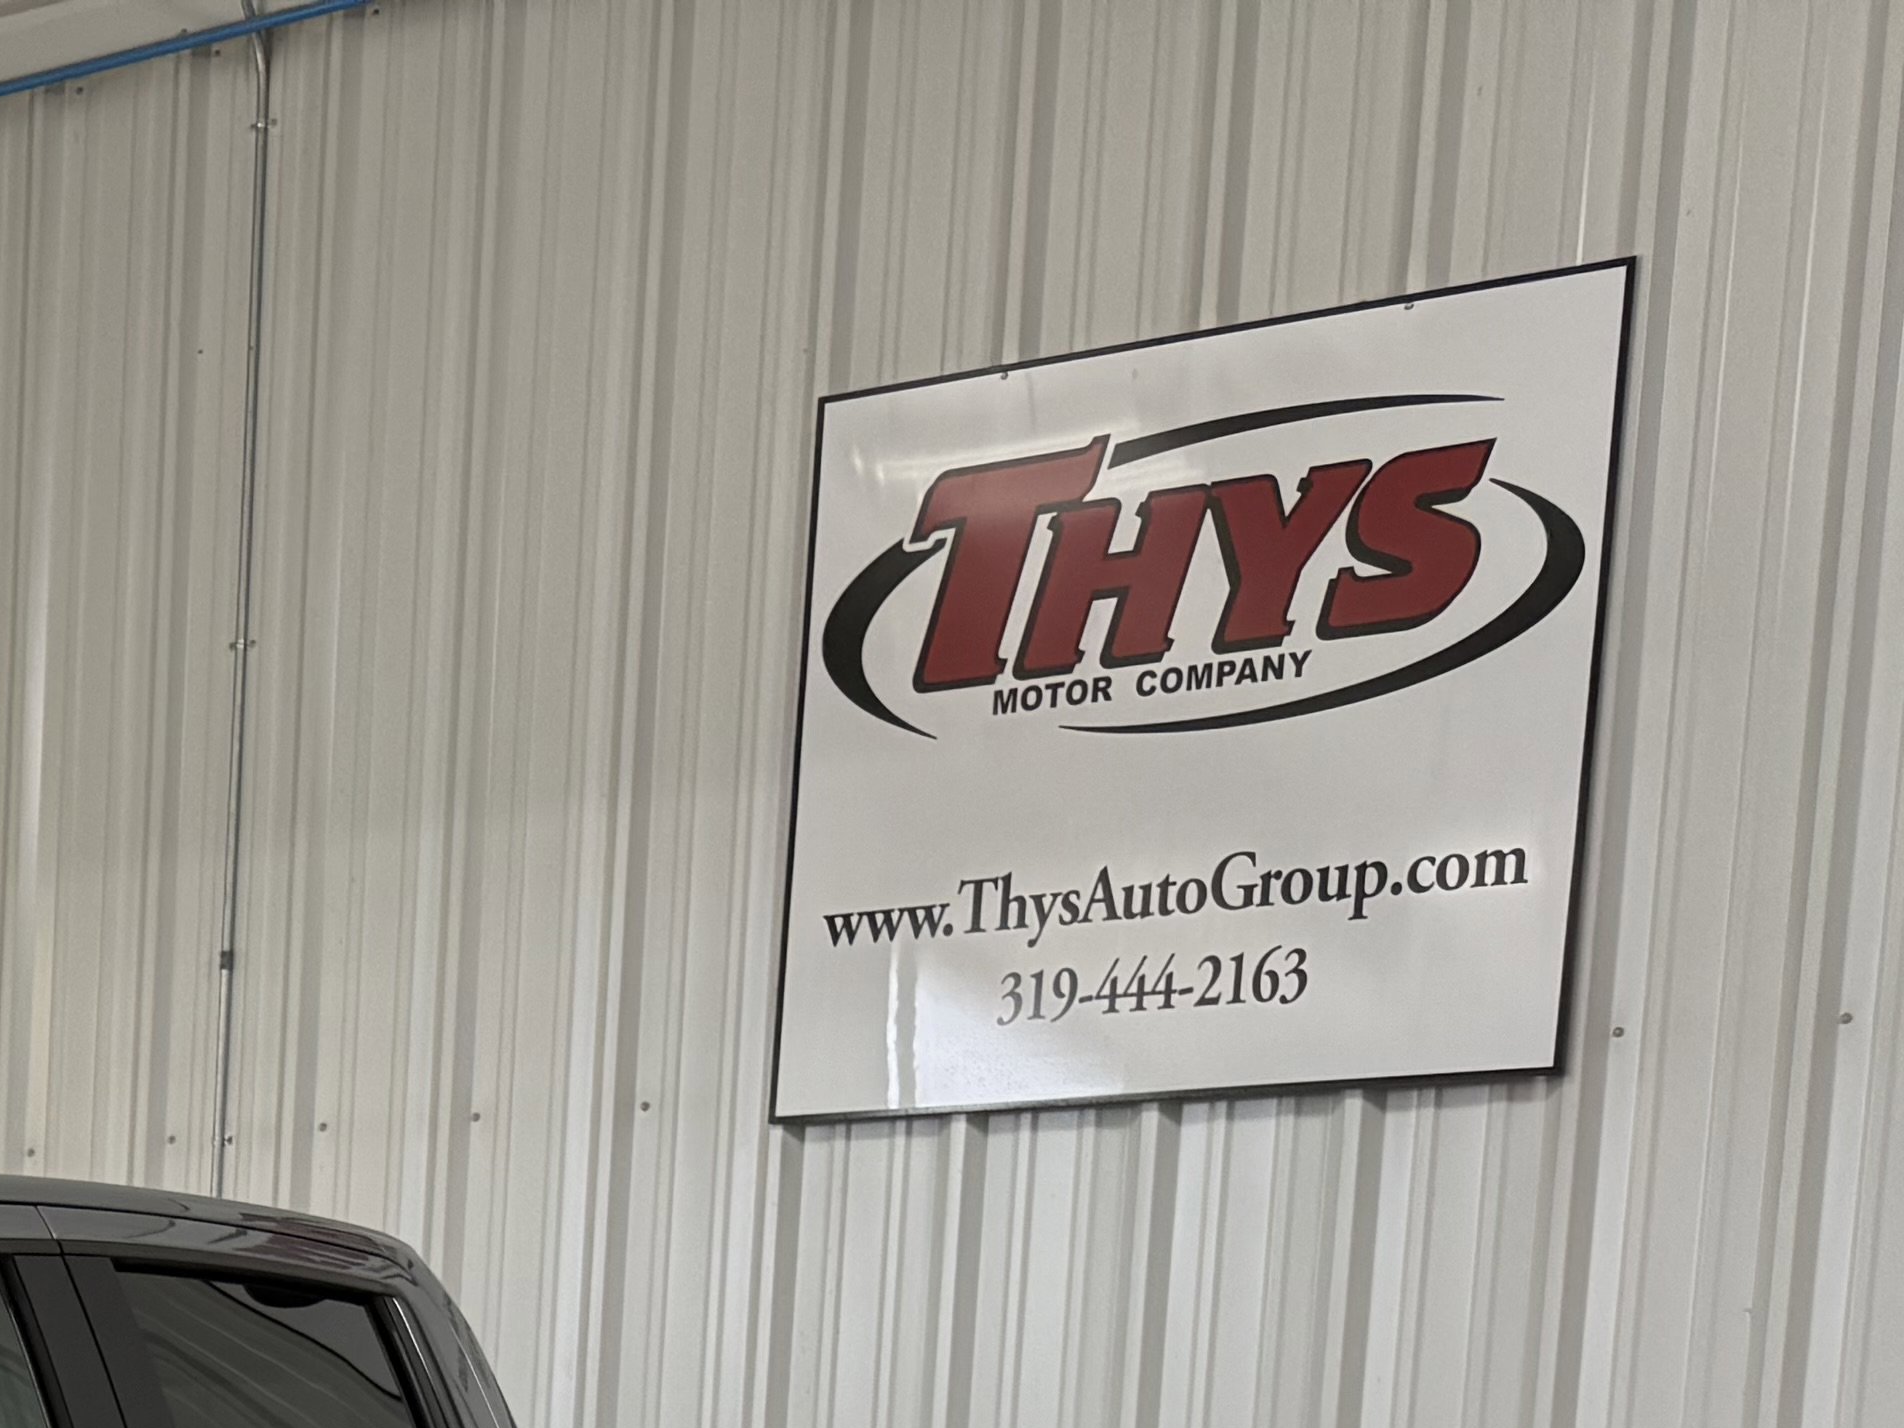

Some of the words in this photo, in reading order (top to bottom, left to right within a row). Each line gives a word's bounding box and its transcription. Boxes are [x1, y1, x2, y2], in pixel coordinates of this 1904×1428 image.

[904, 433, 1498, 695] THYS
[992, 676, 1113, 717] MOTOR
[1135, 651, 1312, 698] COMPANY
[824, 846, 1528, 949] www.ThysAutoGroup.com
[997, 946, 1310, 1026] 319-444-2163
